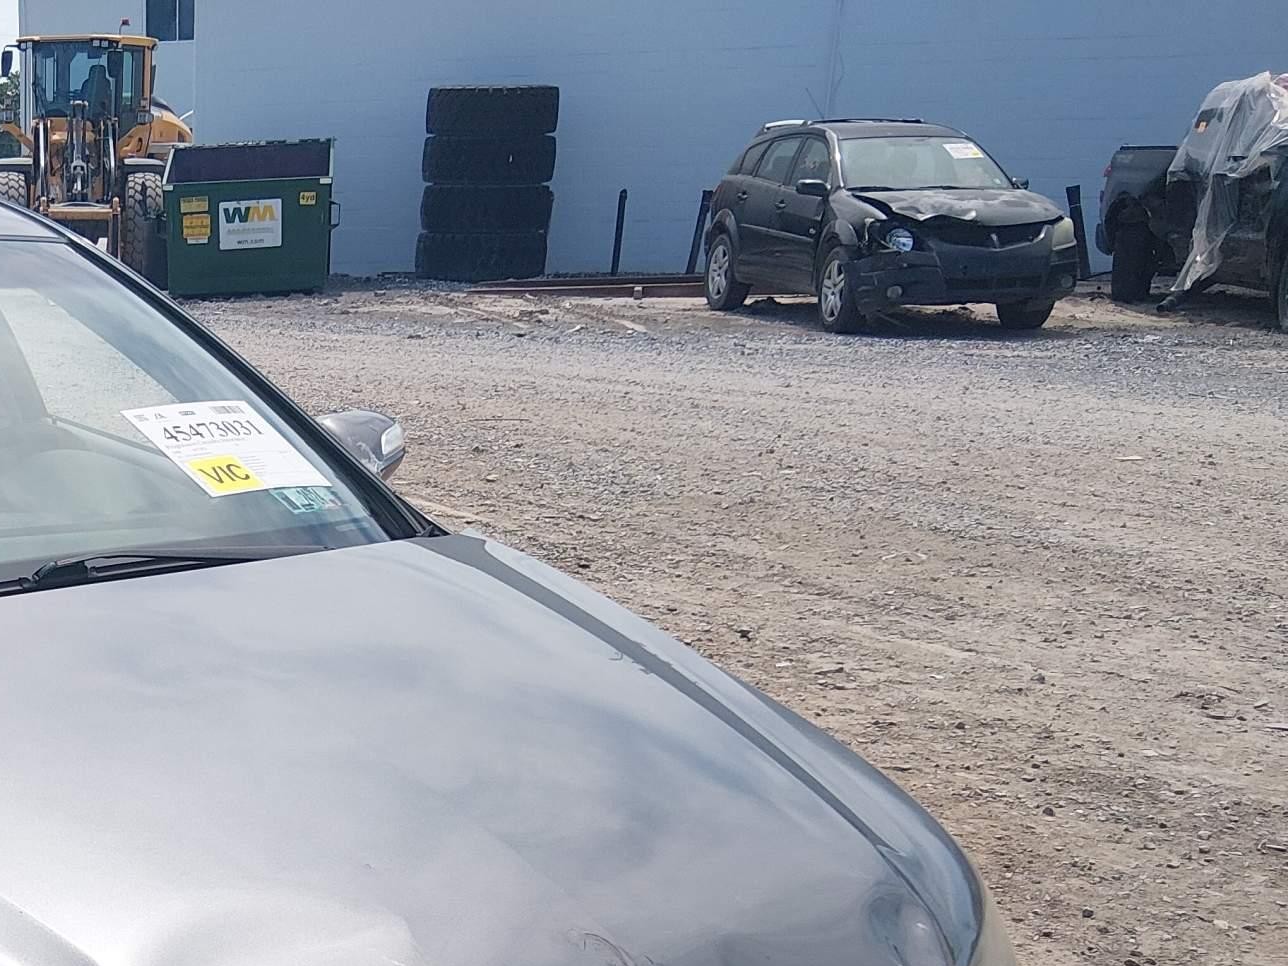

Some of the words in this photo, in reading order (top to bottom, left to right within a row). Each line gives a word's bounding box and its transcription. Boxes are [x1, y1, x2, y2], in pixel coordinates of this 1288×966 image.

[300, 193, 315, 202] 4yd
[223, 205, 276, 224] WM
[162, 419, 264, 442] 45473031
[197, 463, 250, 484] VIC
